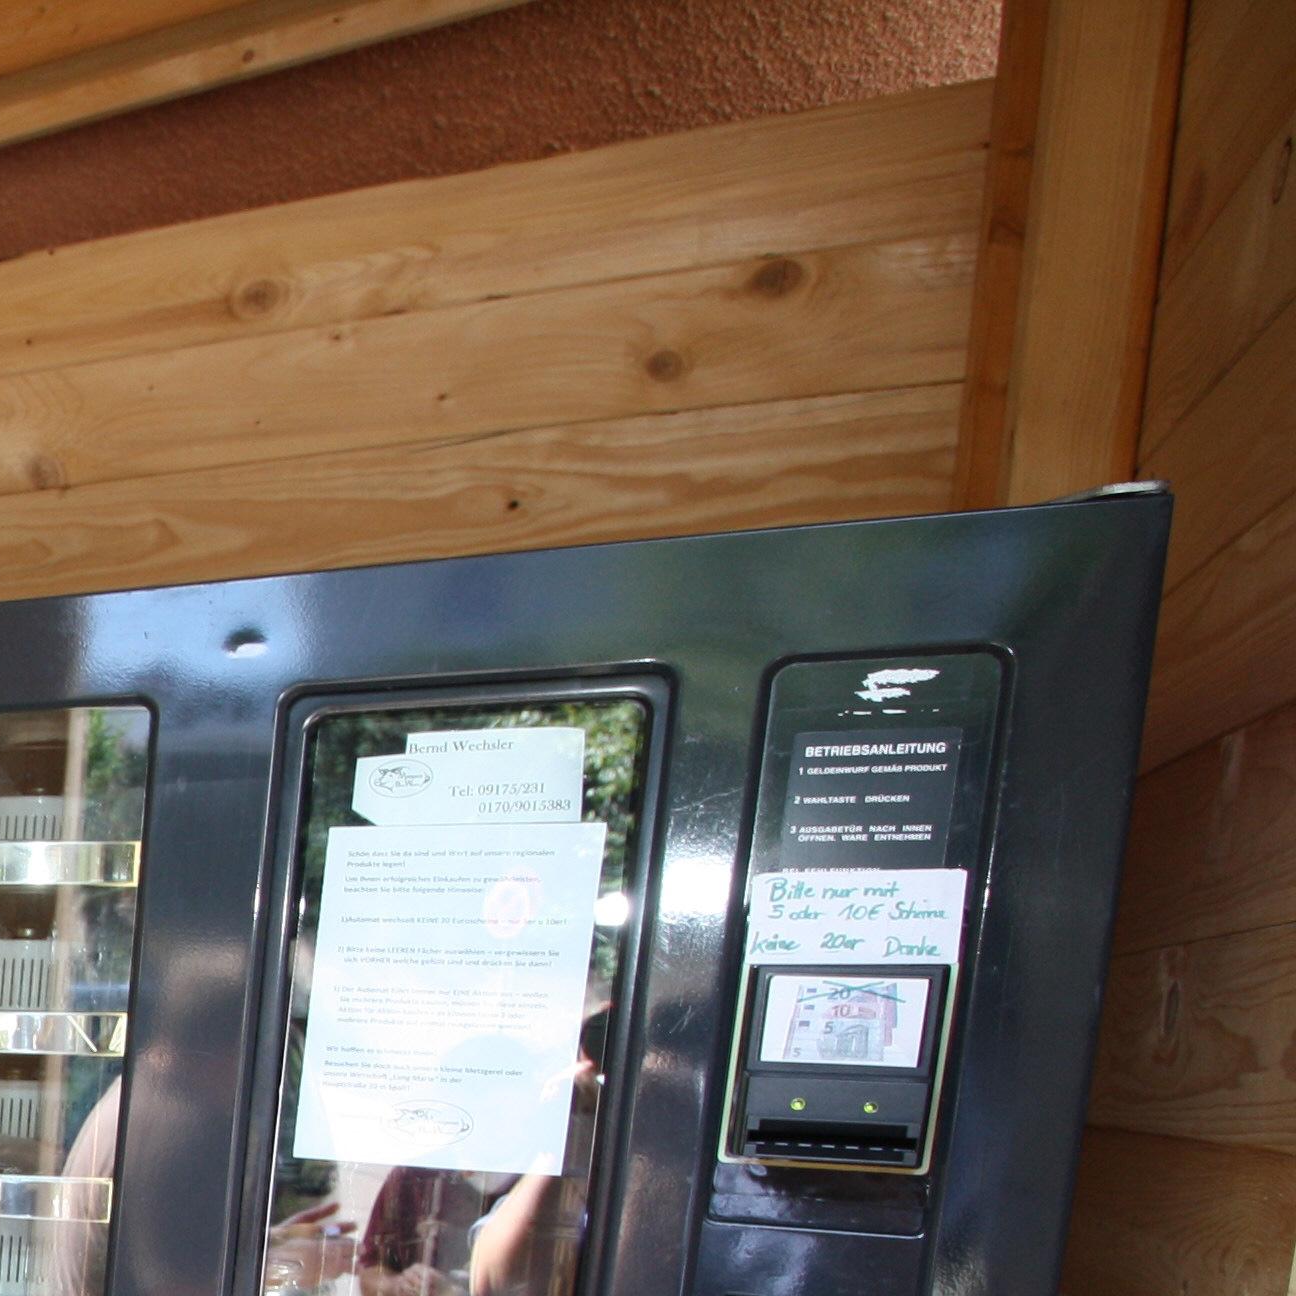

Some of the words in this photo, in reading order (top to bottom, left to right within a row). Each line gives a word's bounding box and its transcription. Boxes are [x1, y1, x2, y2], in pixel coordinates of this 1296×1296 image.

[408, 742, 447, 754] Bernd
[452, 739, 515, 752] Wechsler
[804, 741, 947, 758] BETRIEBSANLEITUNG
[904, 763, 948, 773] PRODUKT
[448, 785, 473, 797] Tel:
[477, 782, 545, 797] 09175/231
[864, 793, 910, 803] DRÜCKEN
[841, 834, 868, 842] WARE
[765, 877, 816, 902] Bitte
[821, 885, 858, 900] nur
[863, 881, 900, 898] mit
[768, 904, 785, 920] 5
[788, 904, 824, 921] oder
[832, 1004, 851, 1017] 10
[823, 1020, 834, 1034] 5
